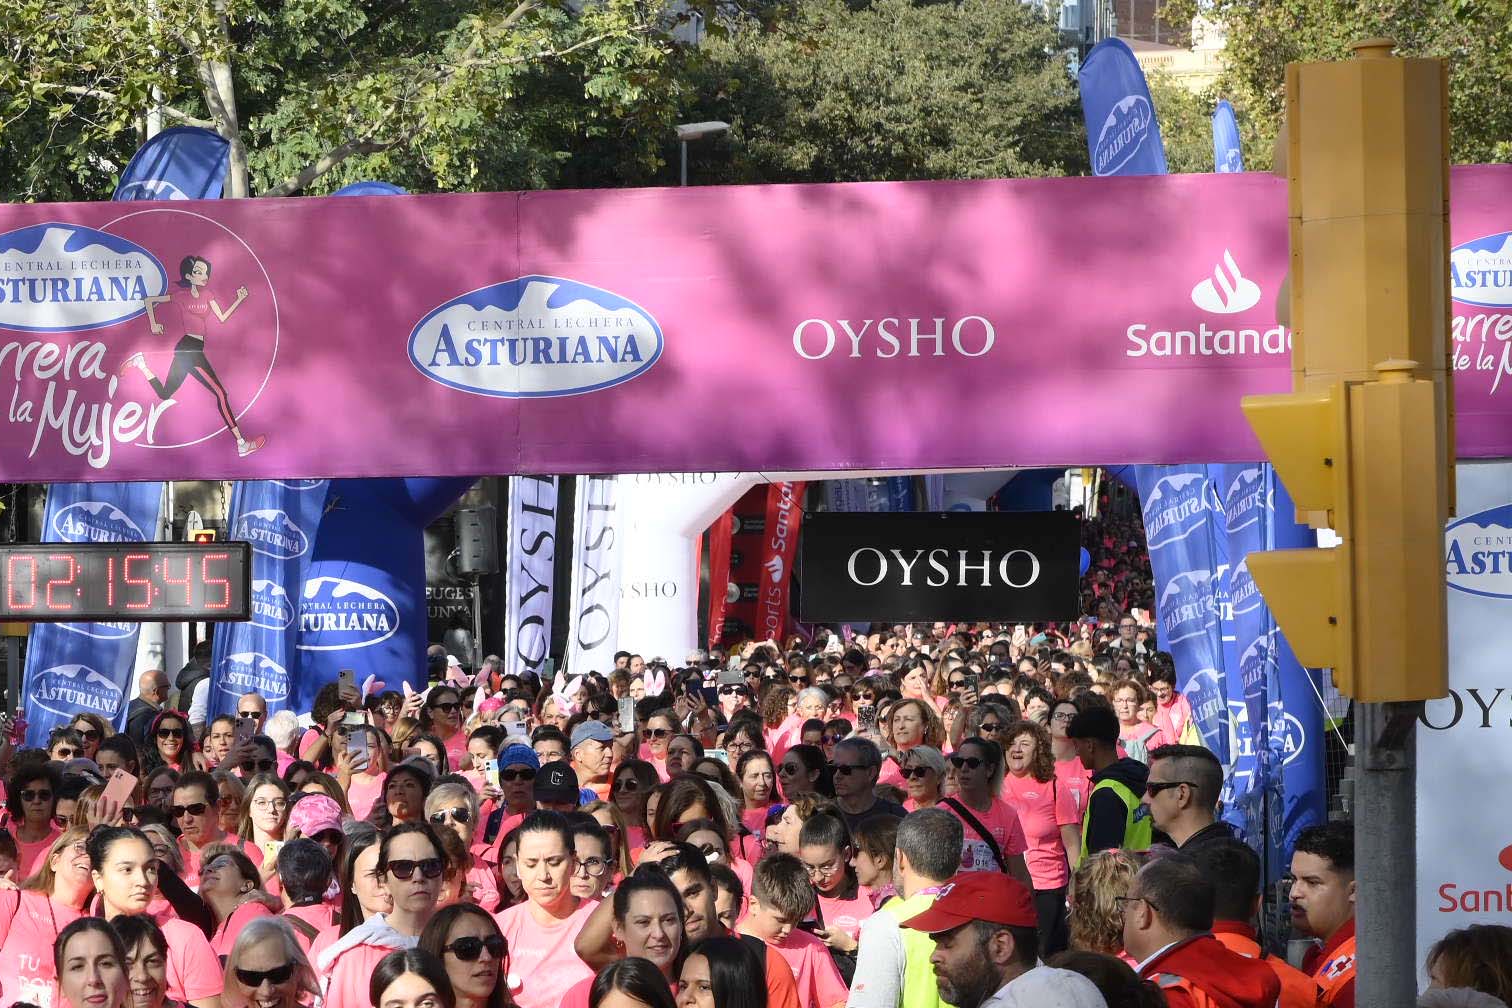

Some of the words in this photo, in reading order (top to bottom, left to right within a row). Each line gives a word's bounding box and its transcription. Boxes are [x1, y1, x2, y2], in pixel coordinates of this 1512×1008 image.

[71, 259, 143, 271] LECHERA
[467, 319, 547, 332] CENTRAL
[554, 317, 636, 330] LECHERA
[793, 316, 995, 360] OYSHO
[1451, 312, 1512, 342] arre
[429, 324, 643, 367] ASTURIANA
[1476, 343, 1494, 371] la
[8, 383, 34, 424] la
[30, 374, 177, 468] Mujer
[517, 476, 555, 669] OYSH
[578, 475, 619, 650] OYSH
[847, 547, 1041, 588] OYSHO
[8, 554, 230, 608] 02:15:45
[619, 581, 677, 599] YSHO
[299, 612, 390, 632] TURIANA
[303, 602, 332, 610] NTRAL
[337, 602, 385, 610] LECHERA
[36, 678, 118, 714] ASTURIANA
[1419, 688, 1512, 731] OY
[19, 954, 40, 970] TU
